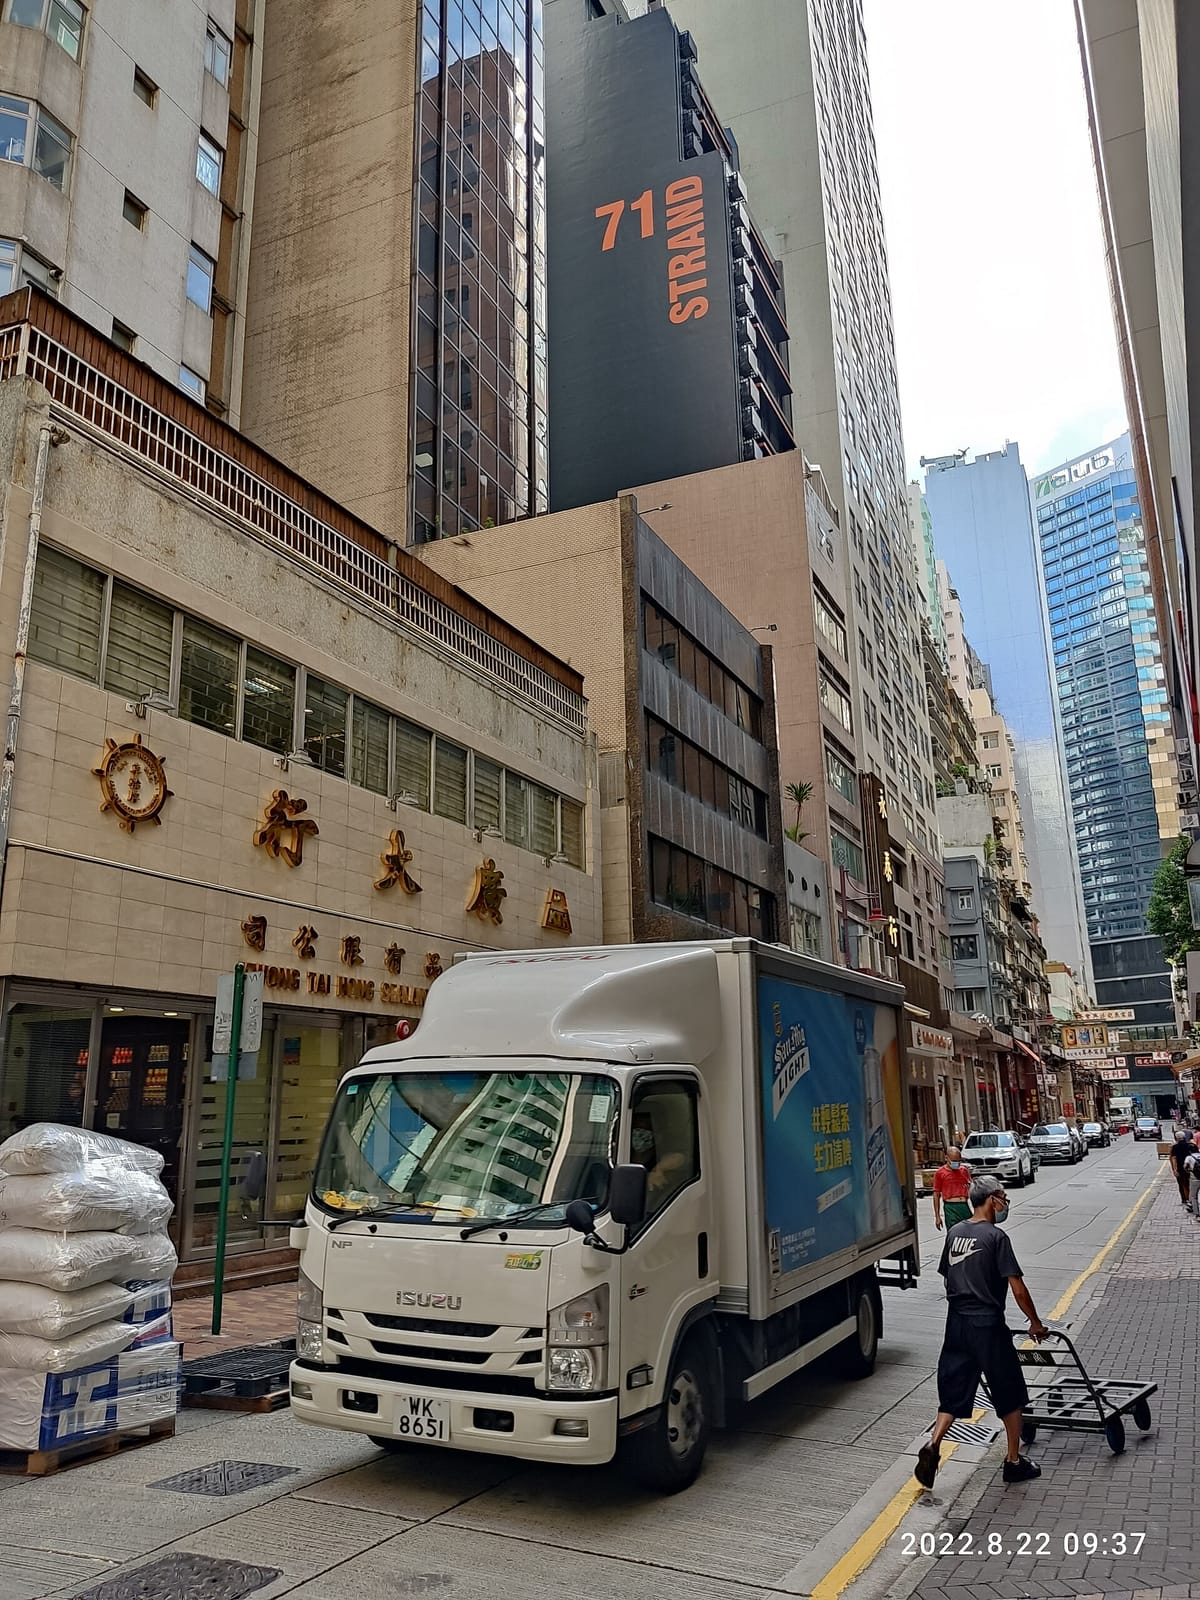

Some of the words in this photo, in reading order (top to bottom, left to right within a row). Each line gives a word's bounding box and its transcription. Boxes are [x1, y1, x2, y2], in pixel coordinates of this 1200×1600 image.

[595, 190, 655, 251] 71
[665, 175, 709, 324] STRAND
[307, 971, 331, 994] TAI
[336, 975, 375, 1001] HONG
[778, 1052, 806, 1100] LIGHT
[951, 1236, 977, 1253] NIKE
[396, 1291, 462, 1311] ISUZU
[409, 1396, 434, 1418] WK
[399, 1415, 444, 1440] 8651
